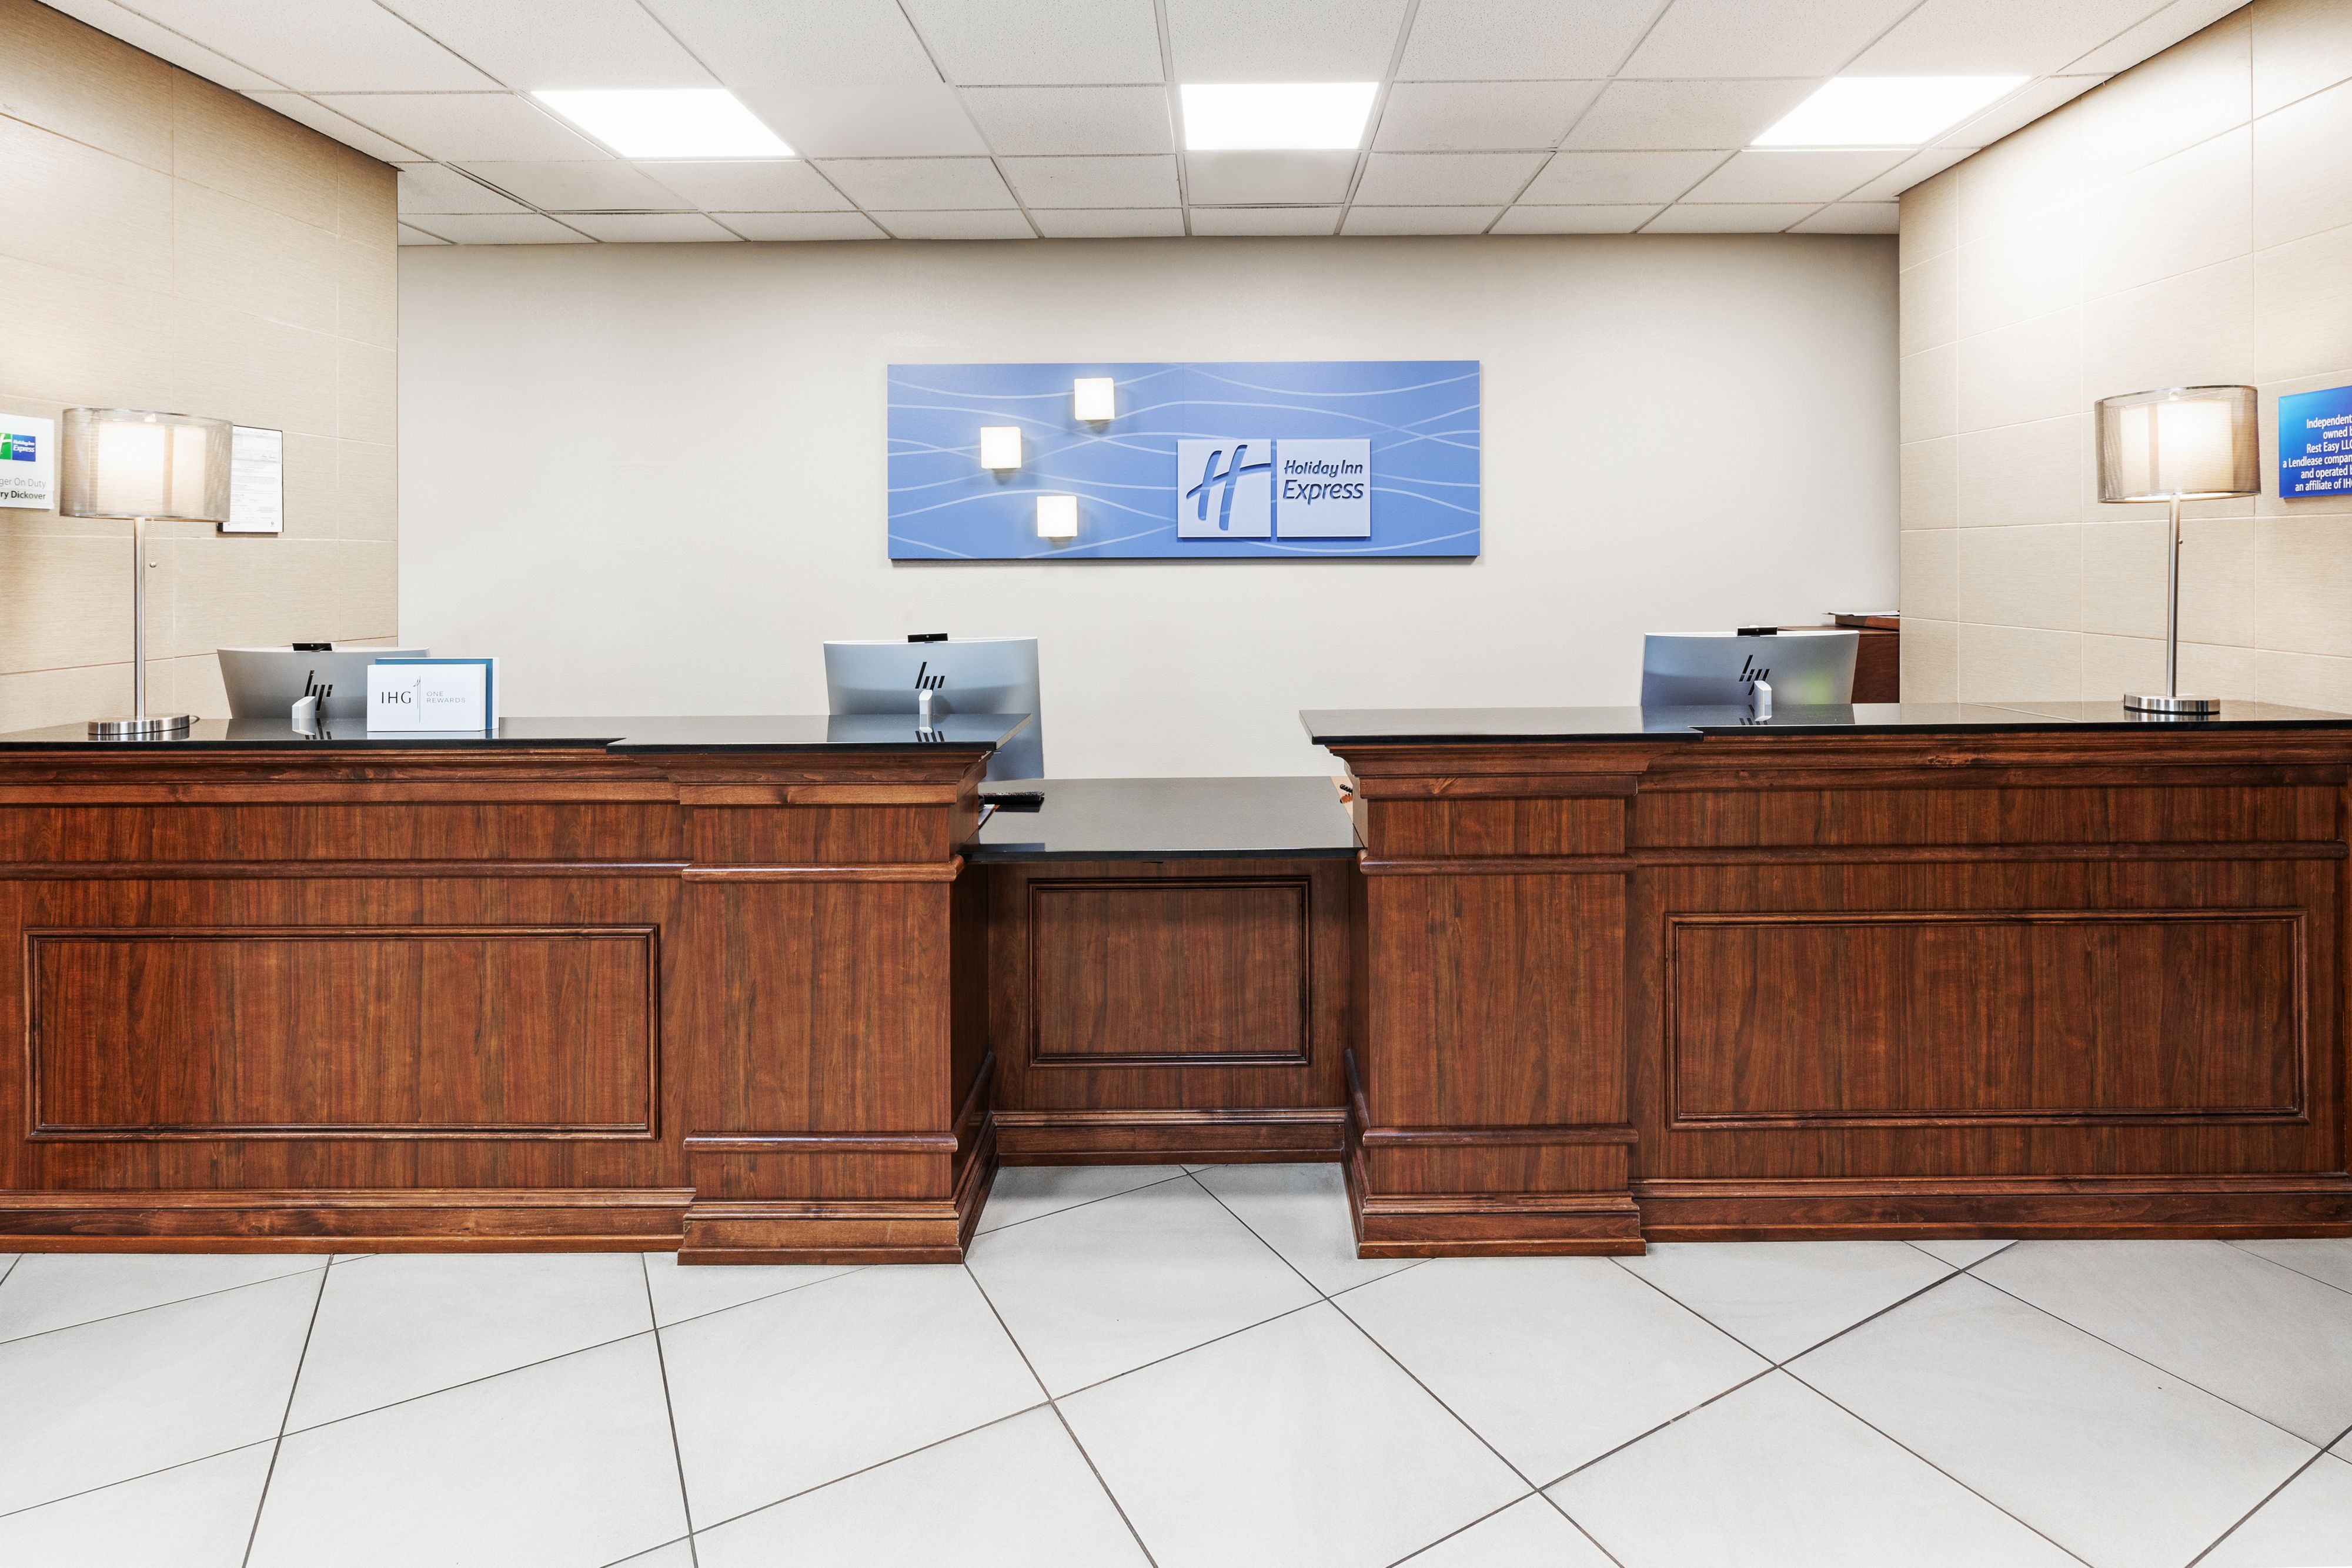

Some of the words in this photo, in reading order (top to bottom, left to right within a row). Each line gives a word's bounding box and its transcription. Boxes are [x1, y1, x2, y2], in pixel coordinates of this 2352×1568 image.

[2307, 414, 2352, 429] Independent
[2323, 426, 2347, 439] owned
[14, 444, 35, 453] Express
[2306, 443, 2322, 453] Rest
[2323, 442, 2340, 454] Easy
[1284, 460, 1339, 477] Holiday
[1341, 460, 1363, 474] Inn
[2288, 456, 2323, 468] Lendlease
[2300, 469, 2314, 479] and
[2315, 464, 2348, 480] operated
[14, 477, 25, 486] On
[28, 479, 46, 490] Duty
[2305, 480, 2332, 492] affiliate
[2333, 478, 2342, 489] of
[2343, 478, 2352, 489] IH
[11, 490, 46, 500] Dickover
[1282, 479, 1364, 505] Express
[382, 691, 411, 704] IHG
